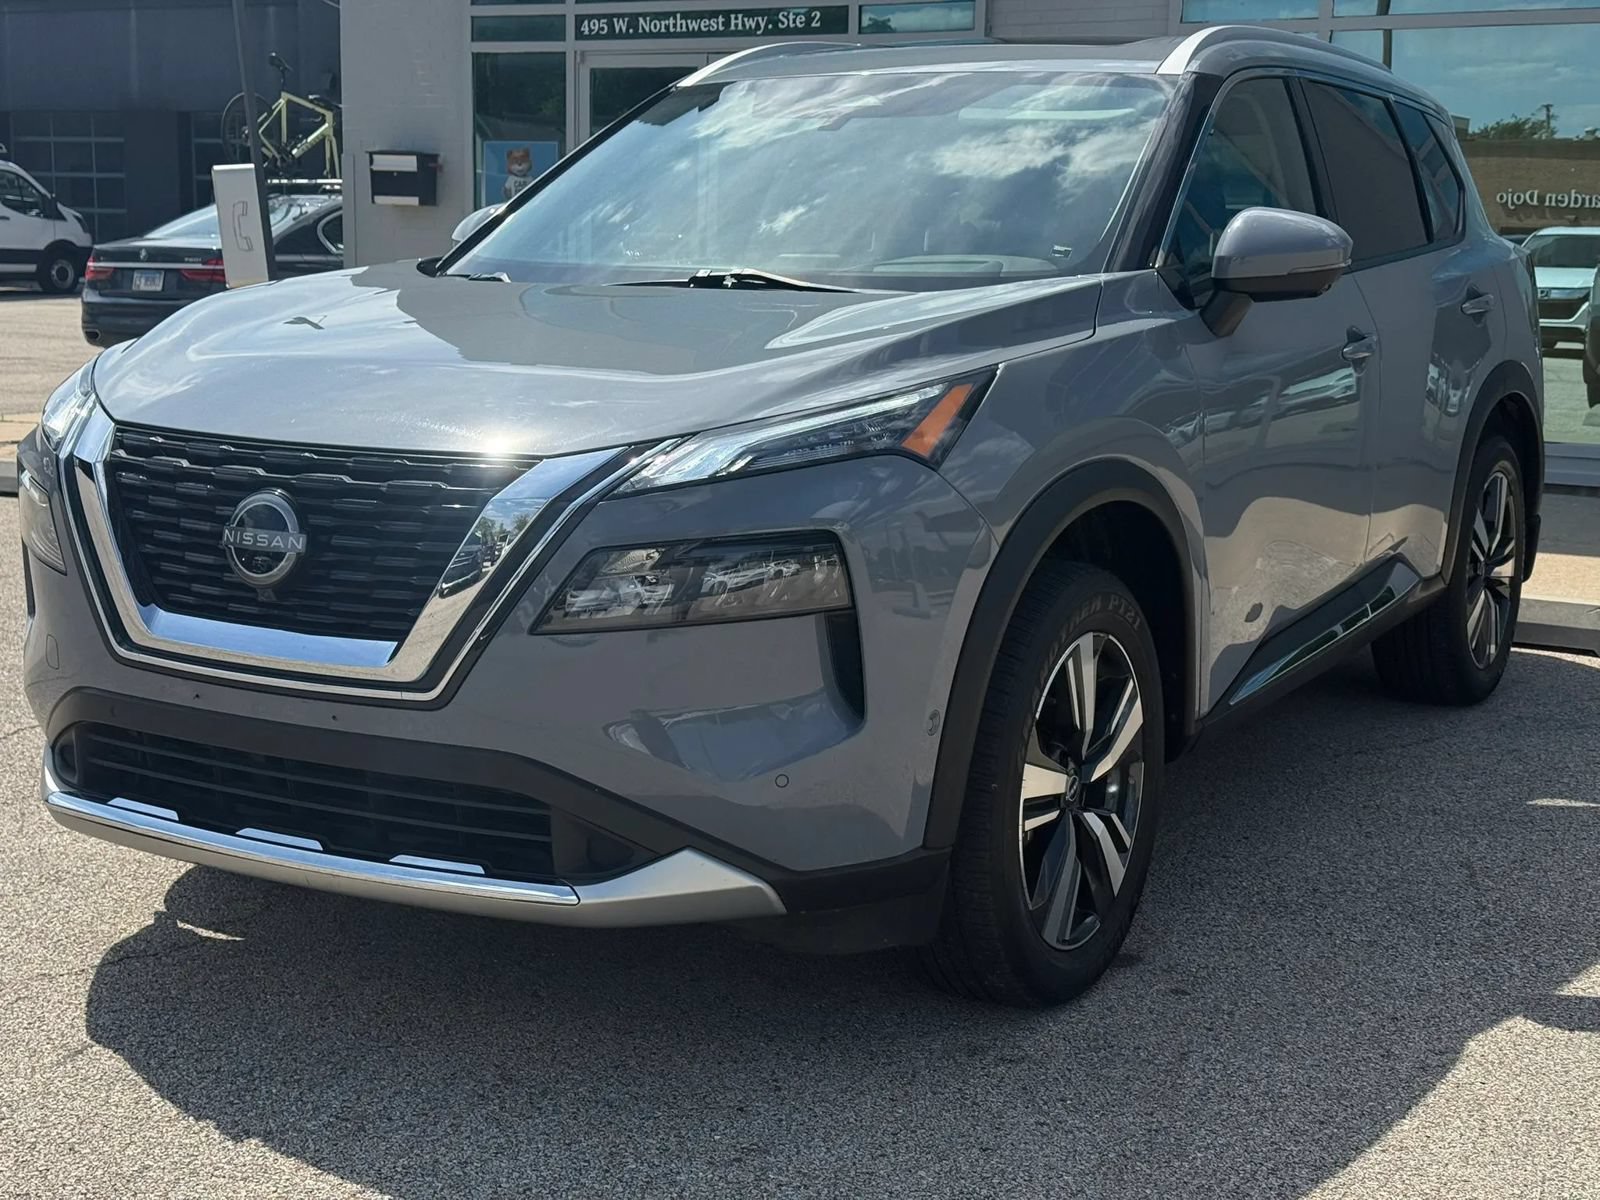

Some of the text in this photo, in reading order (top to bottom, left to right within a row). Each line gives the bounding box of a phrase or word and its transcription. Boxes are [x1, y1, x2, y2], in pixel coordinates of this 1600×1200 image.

[580, 11, 821, 35] 495 W. Northwest Hwy. Ste 2
[224, 529, 303, 549] NISSAN
